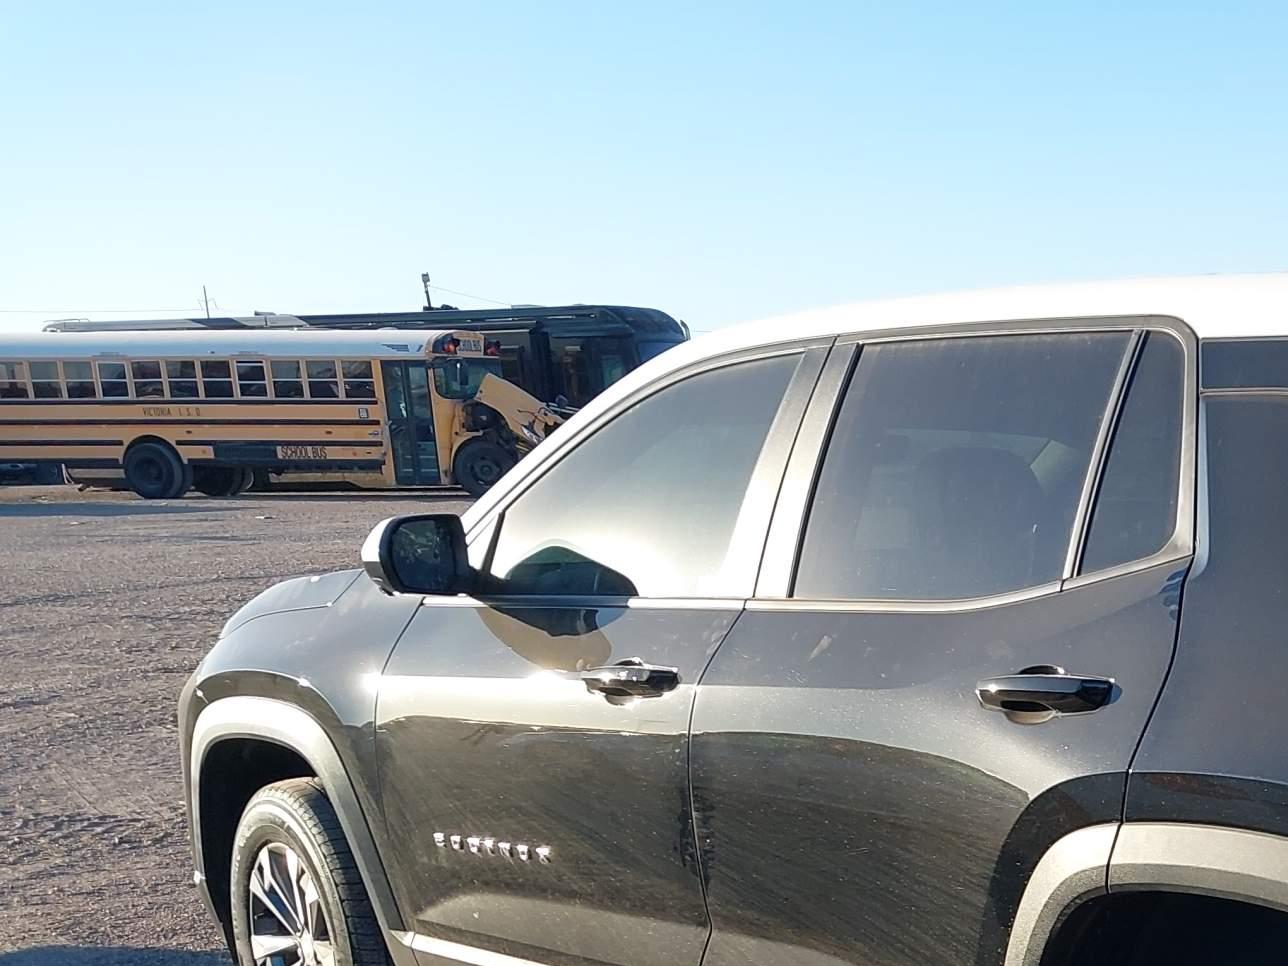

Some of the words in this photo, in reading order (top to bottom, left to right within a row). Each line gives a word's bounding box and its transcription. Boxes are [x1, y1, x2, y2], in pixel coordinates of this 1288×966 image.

[142, 407, 172, 417] VICTORIA
[280, 446, 311, 459] SCHOOL
[312, 446, 327, 459] BUS
